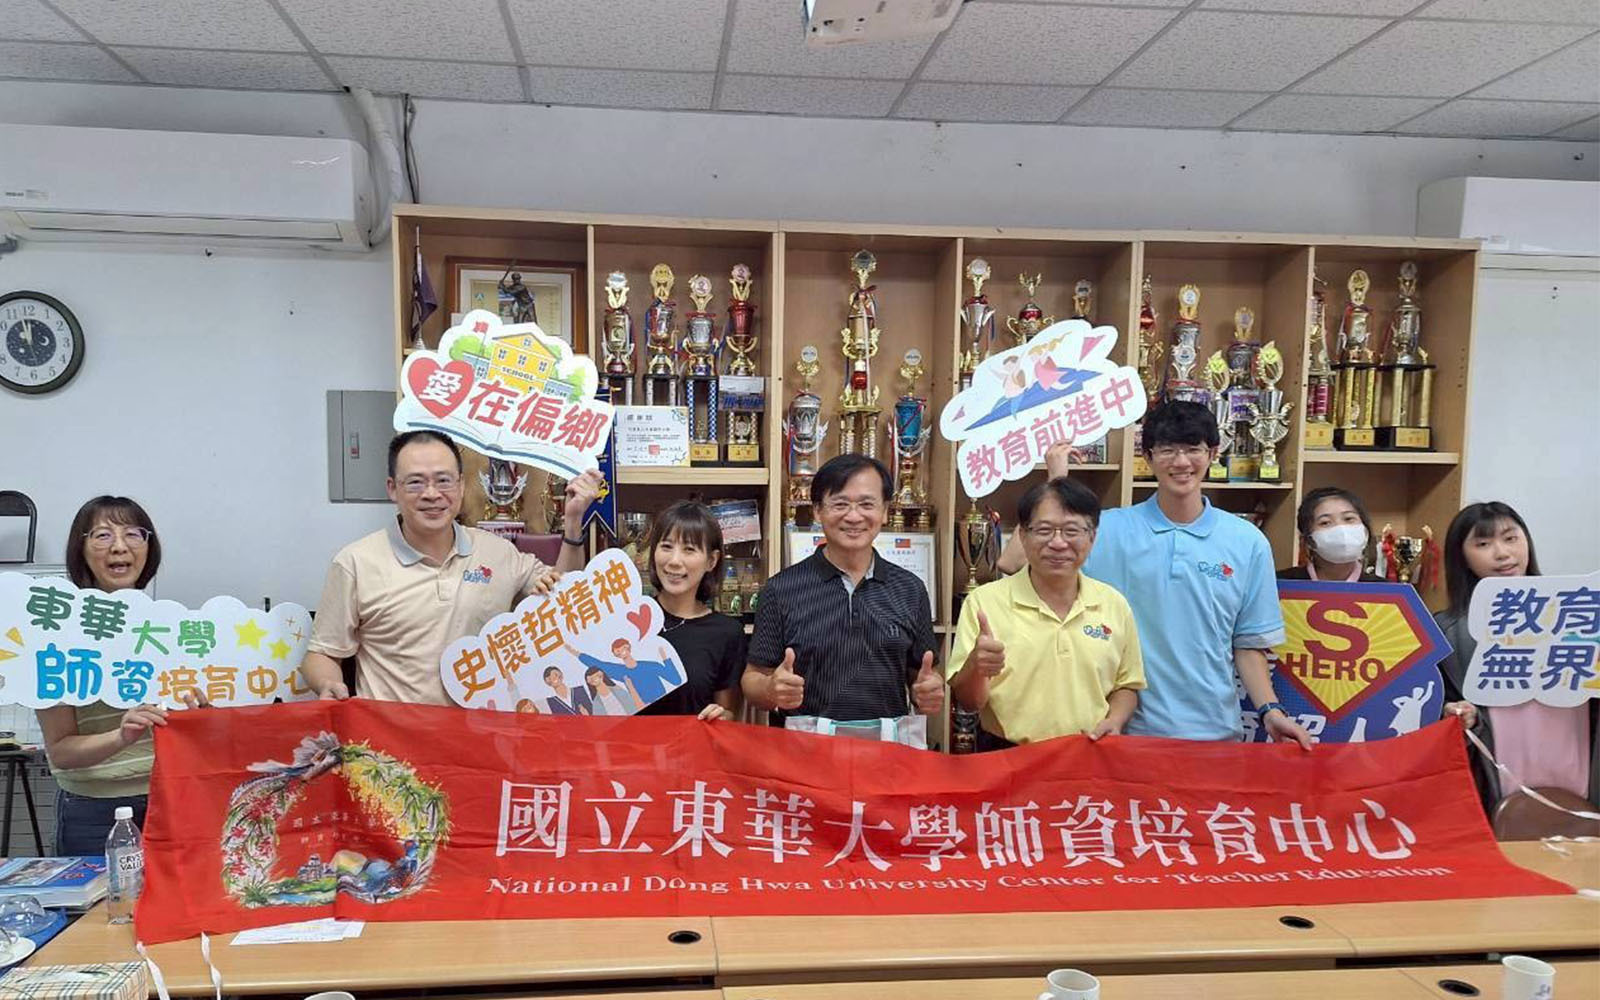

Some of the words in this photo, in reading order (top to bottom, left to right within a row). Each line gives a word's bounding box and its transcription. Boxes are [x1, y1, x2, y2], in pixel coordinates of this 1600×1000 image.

[23, 305, 35, 316] 12
[45, 308, 50, 319] 1
[56, 320, 64, 331] 2
[63, 337, 70, 348] 3
[30, 369, 38, 380] 6
[49, 366, 56, 377] 5
[502, 366, 534, 380] SCHOOL
[419, 369, 608, 452] 愛在偏鄉
[966, 377, 1134, 489] 教育前進中
[26, 586, 217, 658] 東華大學
[1488, 586, 1600, 635] 教育
[452, 559, 632, 702] 史懷哲精神
[1303, 600, 1370, 661] S
[1286, 652, 1386, 683] HERO
[1478, 643, 1596, 691] 無界
[495, 779, 1417, 872] 國立東華大學師資培育中心
[486, 876, 630, 894] National
[643, 876, 729, 894] Dong
[740, 876, 811, 891] Hwa
[822, 876, 987, 892] University
[998, 875, 1104, 888] Center
[1113, 874, 1161, 885] for
[1164, 870, 1291, 885] Teacher
[1297, 865, 1455, 881] Education
